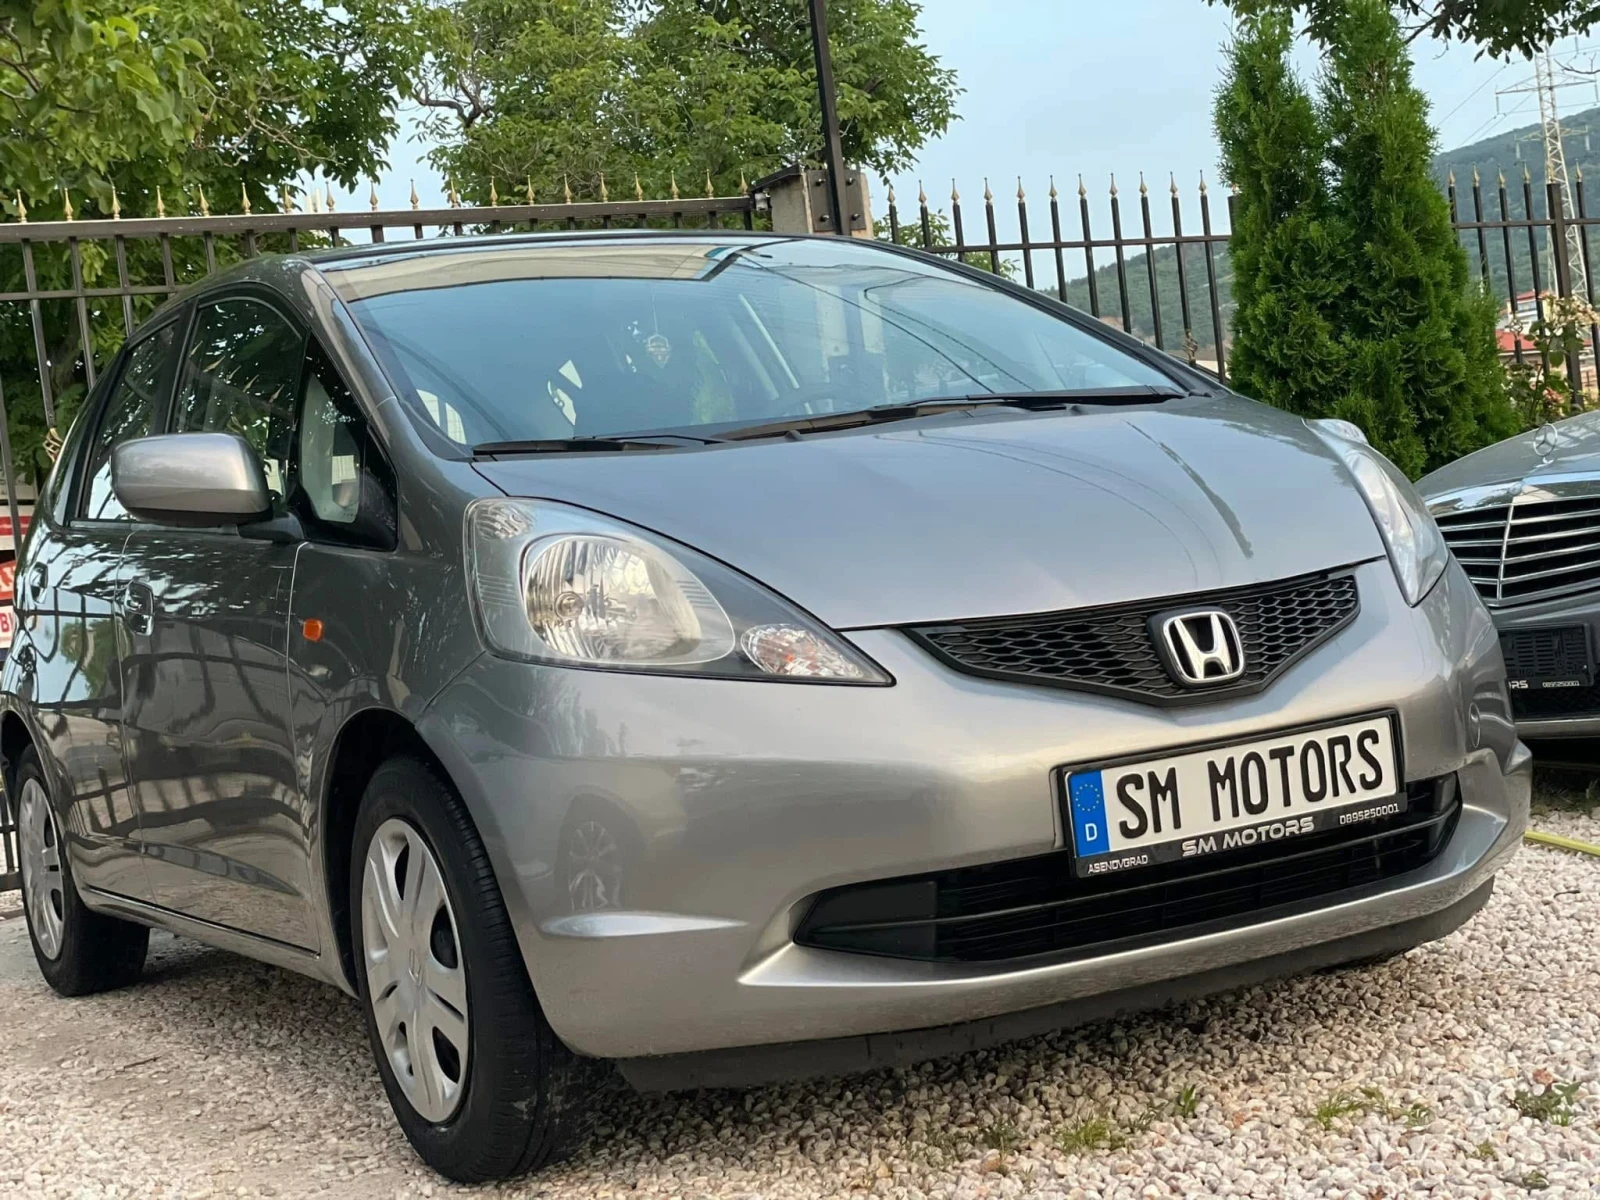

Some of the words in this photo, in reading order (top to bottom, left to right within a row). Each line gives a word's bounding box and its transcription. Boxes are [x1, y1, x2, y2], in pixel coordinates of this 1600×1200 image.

[1508, 680, 1529, 689] RS
[1116, 767, 1182, 839] SM
[1207, 728, 1384, 821] MOTORS
[1084, 823, 1098, 841] D
[1087, 854, 1149, 874] ASENOVGRAD
[1182, 836, 1217, 857] SM
[1223, 816, 1315, 849] MOTORS
